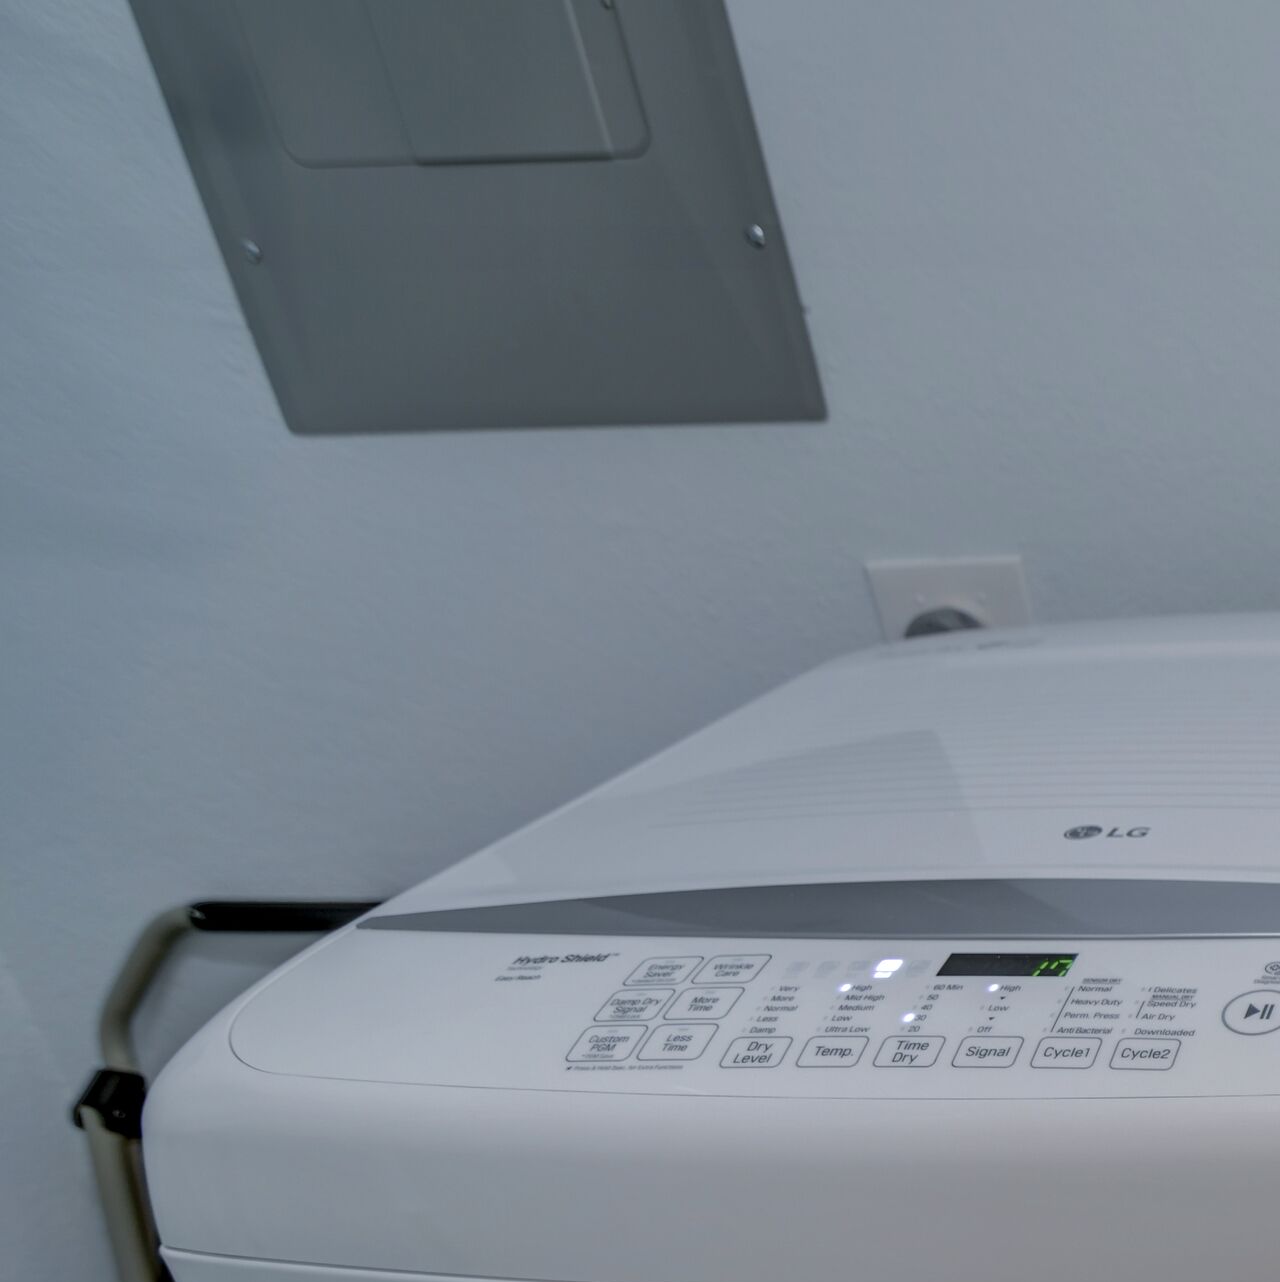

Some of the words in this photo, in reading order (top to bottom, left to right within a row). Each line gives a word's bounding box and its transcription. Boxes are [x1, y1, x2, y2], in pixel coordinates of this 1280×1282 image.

[513, 957, 559, 965] Hydro
[1032, 959, 1074, 976] 17
[999, 984, 1022, 993] High
[1154, 986, 1198, 994] Delicates
[749, 1026, 777, 1034] Damp
[1134, 1028, 1196, 1036] Downloaded
[662, 1043, 688, 1051] Time
[747, 1041, 773, 1052] Dry
[897, 1041, 930, 1051] Time
[814, 1046, 854, 1057] Temp.
[965, 1046, 1011, 1058] Signal
[1043, 1047, 1090, 1060] Cycle1
[1121, 1048, 1171, 1060] Cycle2
[733, 1054, 773, 1063] Level
[891, 1052, 919, 1064] Dry
